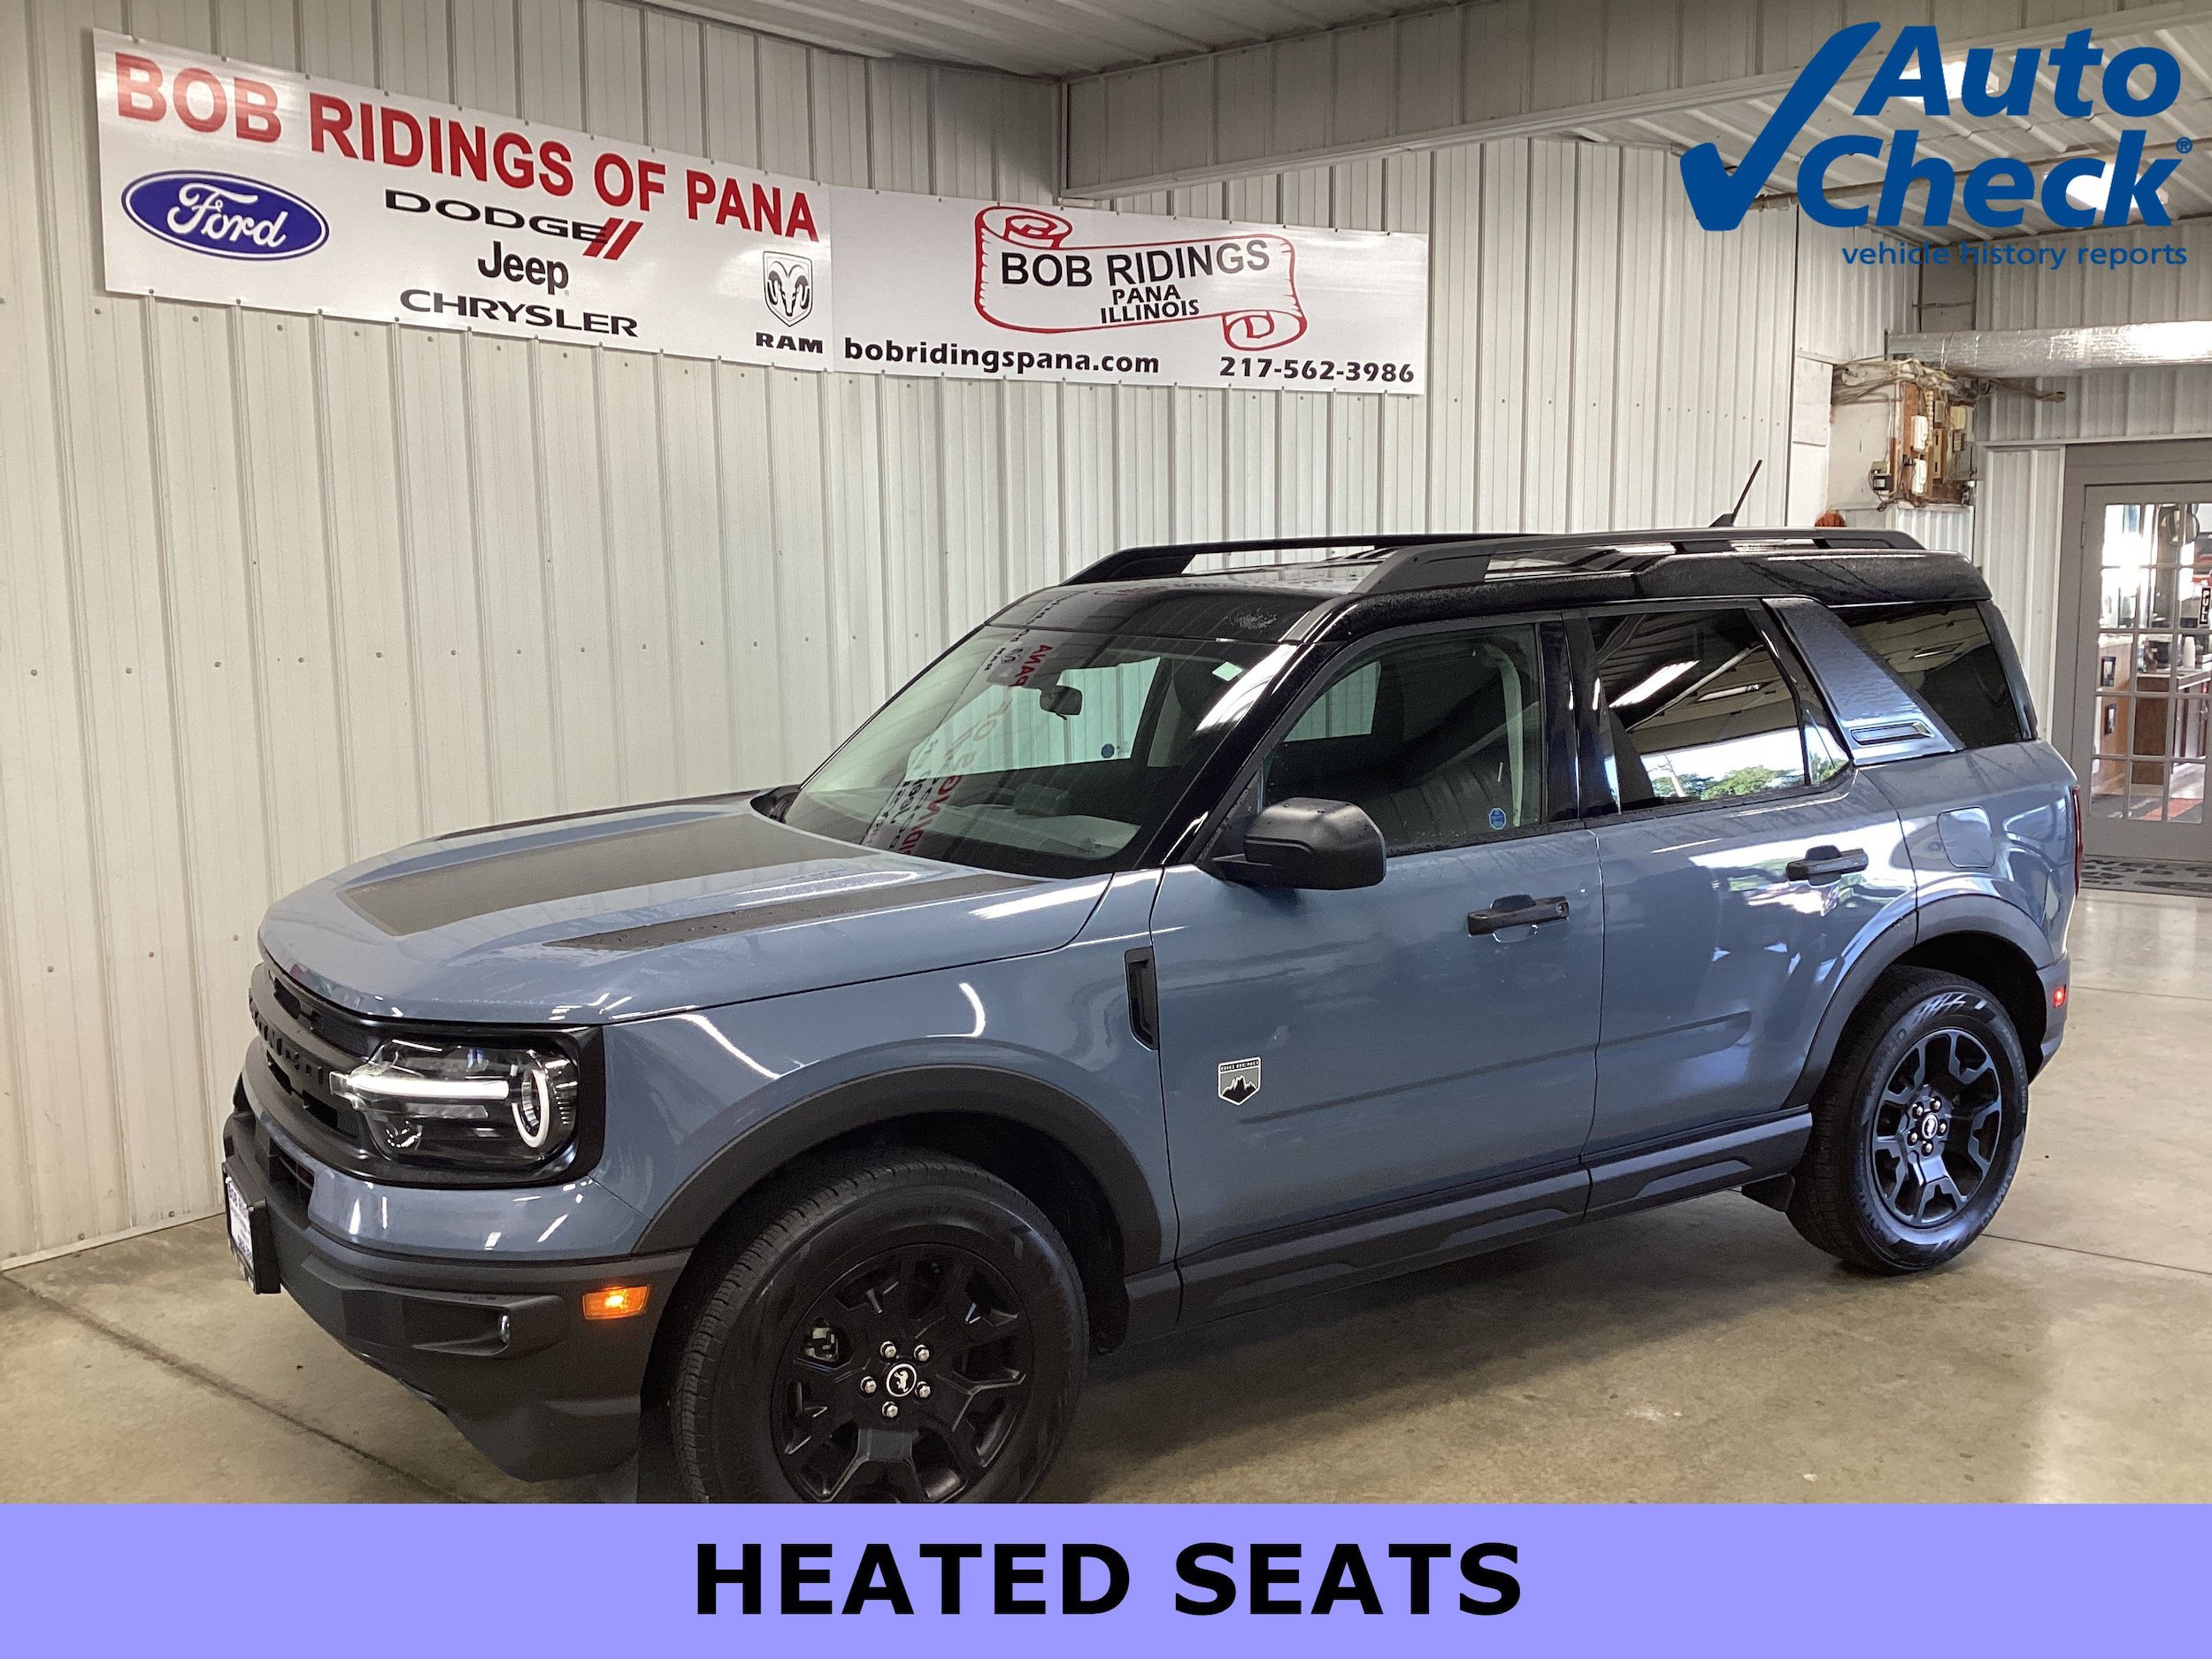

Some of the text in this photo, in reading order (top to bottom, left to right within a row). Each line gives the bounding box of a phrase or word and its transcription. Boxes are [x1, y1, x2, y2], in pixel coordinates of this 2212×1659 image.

[115, 52, 819, 242] BOB RIDINGS OF PANA
[166, 182, 288, 249] Ford
[384, 188, 608, 244] DODGE
[477, 240, 569, 296] Jeep
[1002, 239, 1270, 288] BOB RIDINGS
[400, 288, 639, 338] CHRYSLER
[1101, 299, 1200, 324] ILLINOIS
[1111, 284, 1181, 305] PANA
[756, 332, 823, 354] RAM
[845, 337, 1160, 380] bobridingspana.com
[1220, 357, 1415, 383] 217-562-3986
[2201, 590, 2210, 622] PULL
